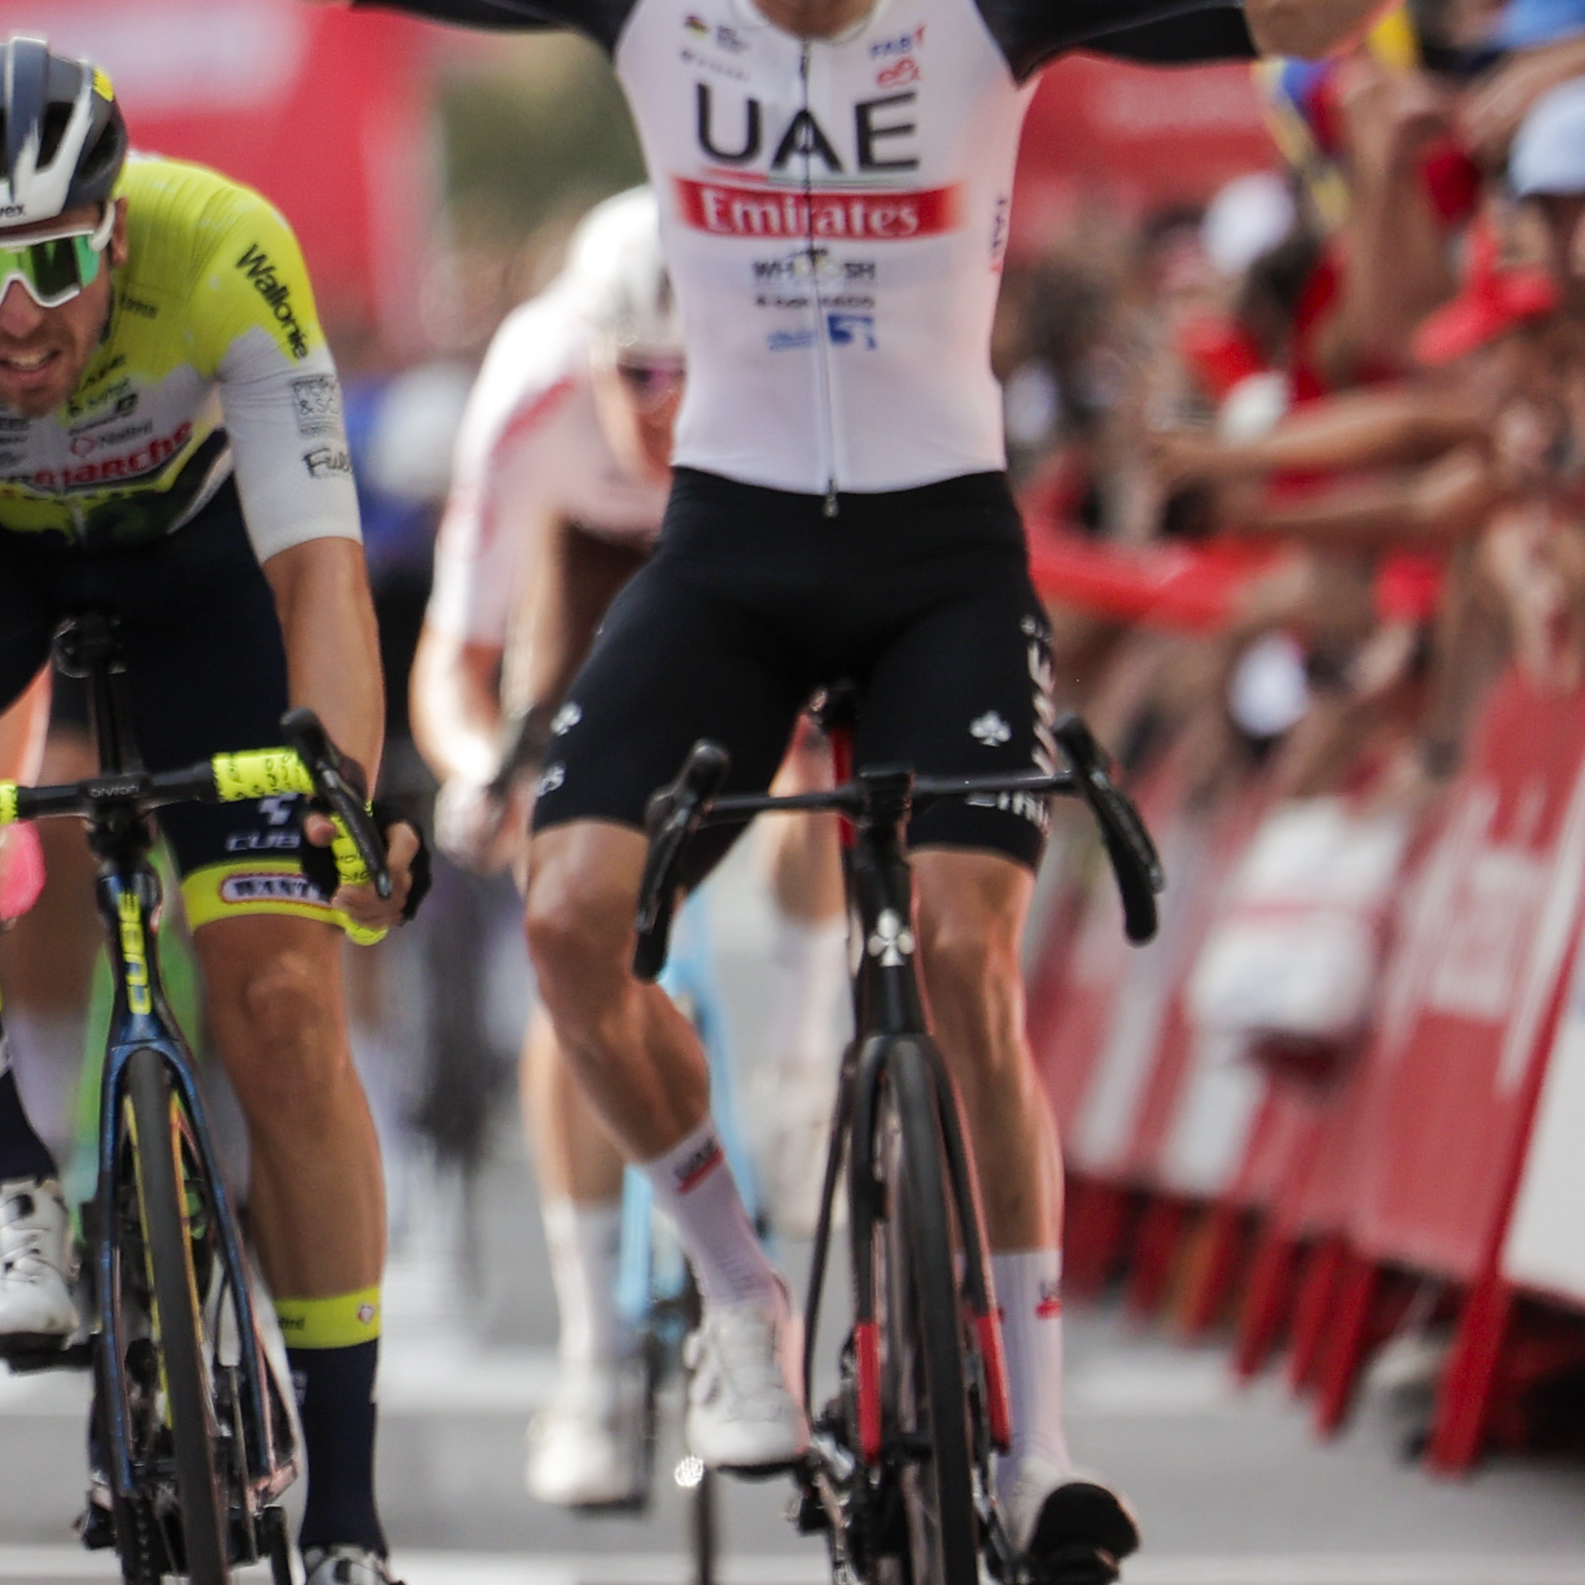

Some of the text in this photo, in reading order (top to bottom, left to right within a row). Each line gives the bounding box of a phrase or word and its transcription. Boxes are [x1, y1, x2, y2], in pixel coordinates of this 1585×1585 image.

[696, 82, 921, 174] UAE
[700, 187, 921, 238] Emirates
[234, 243, 309, 360] Wallonie
